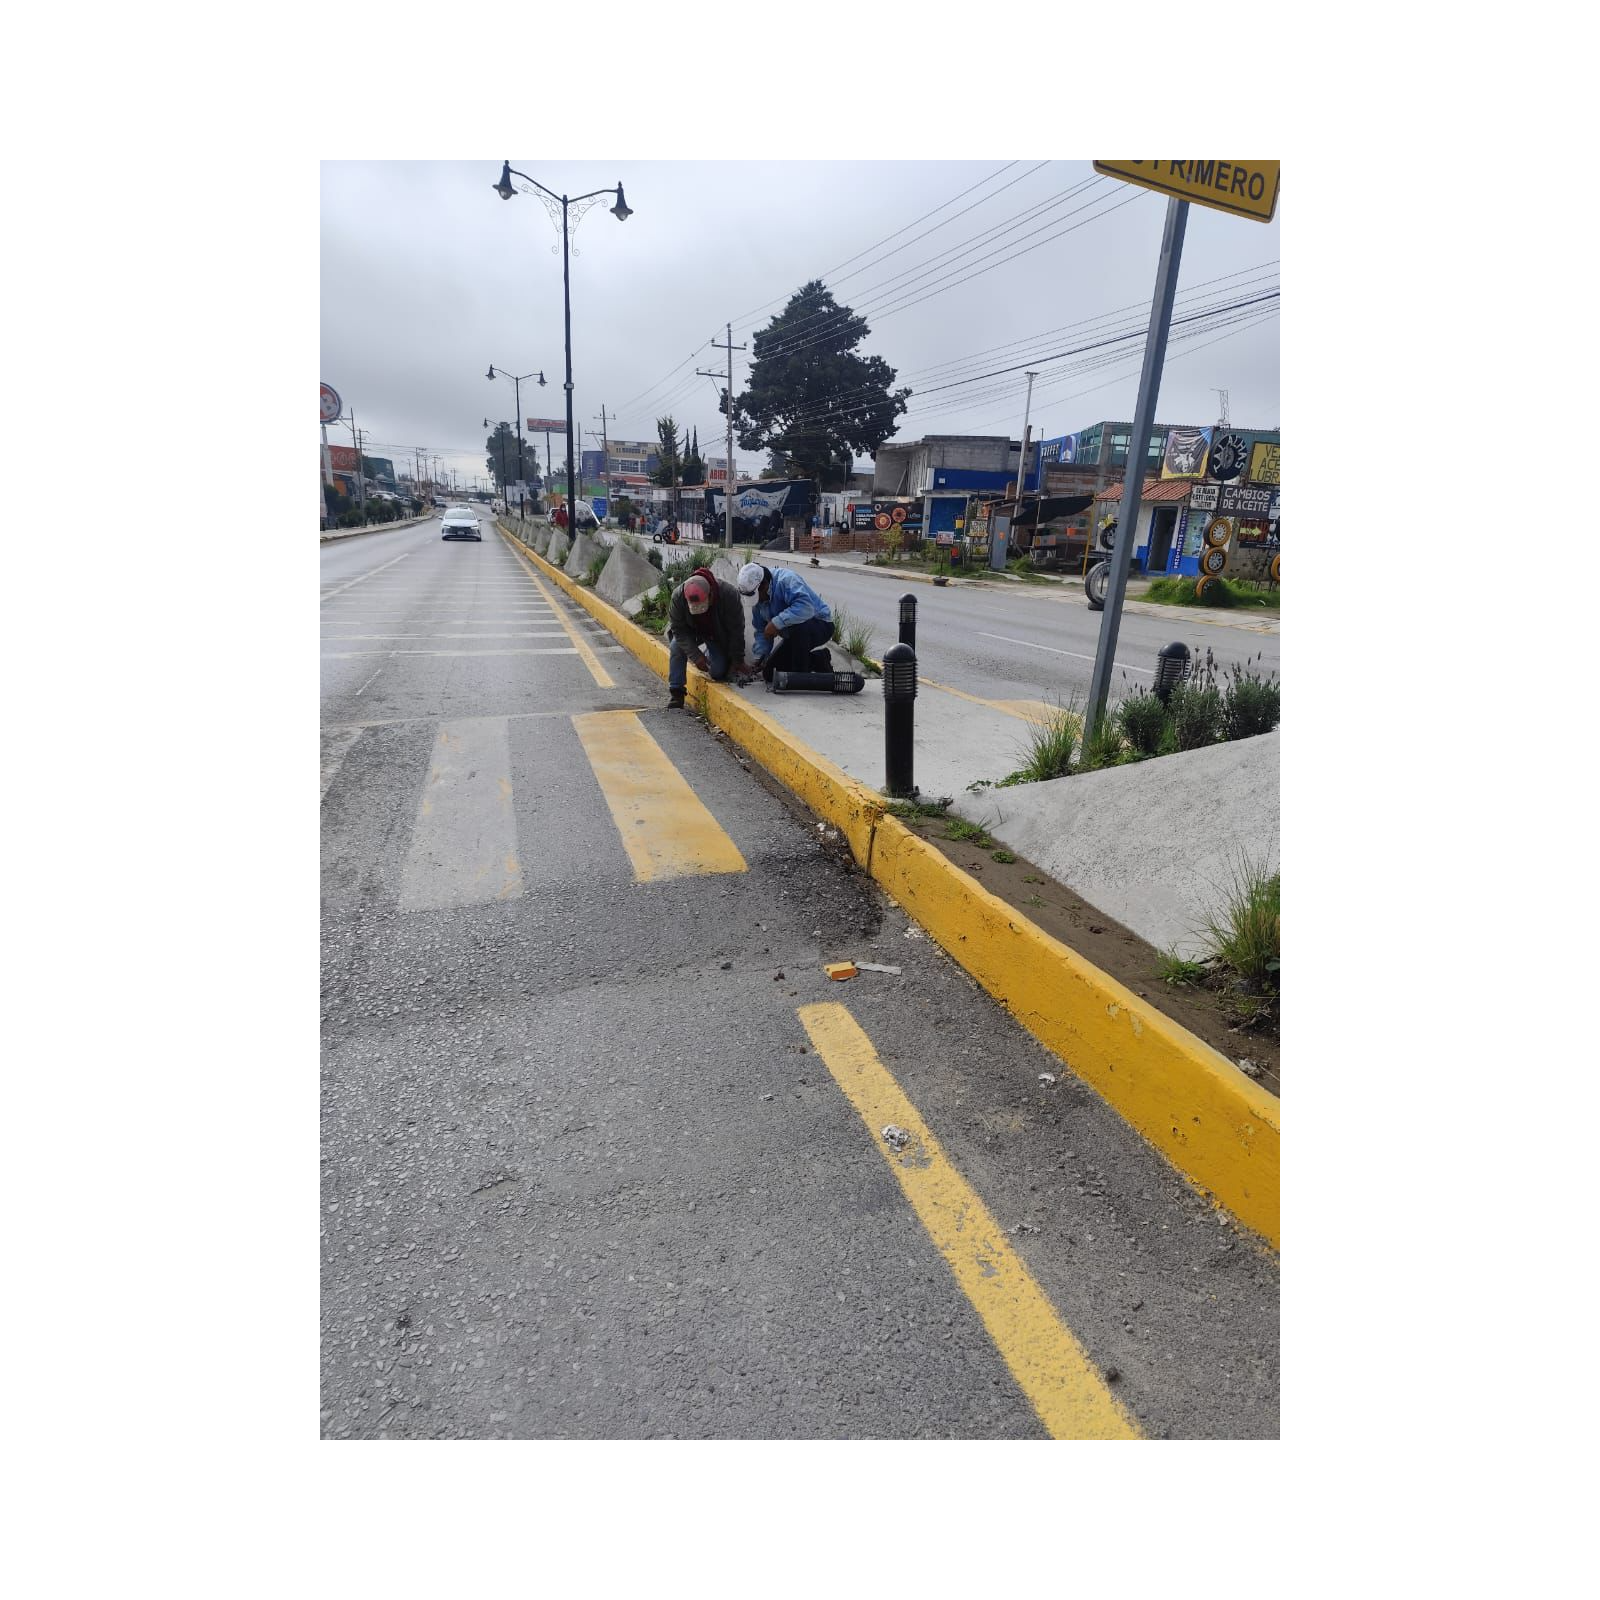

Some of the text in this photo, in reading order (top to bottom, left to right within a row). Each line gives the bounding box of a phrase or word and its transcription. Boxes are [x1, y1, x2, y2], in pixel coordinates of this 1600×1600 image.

[709, 469, 735, 481] ABIERO
[1224, 487, 1271, 500] CAMBIOS
[1222, 498, 1233, 510] DE
[1236, 500, 1269, 512] ACEITE
